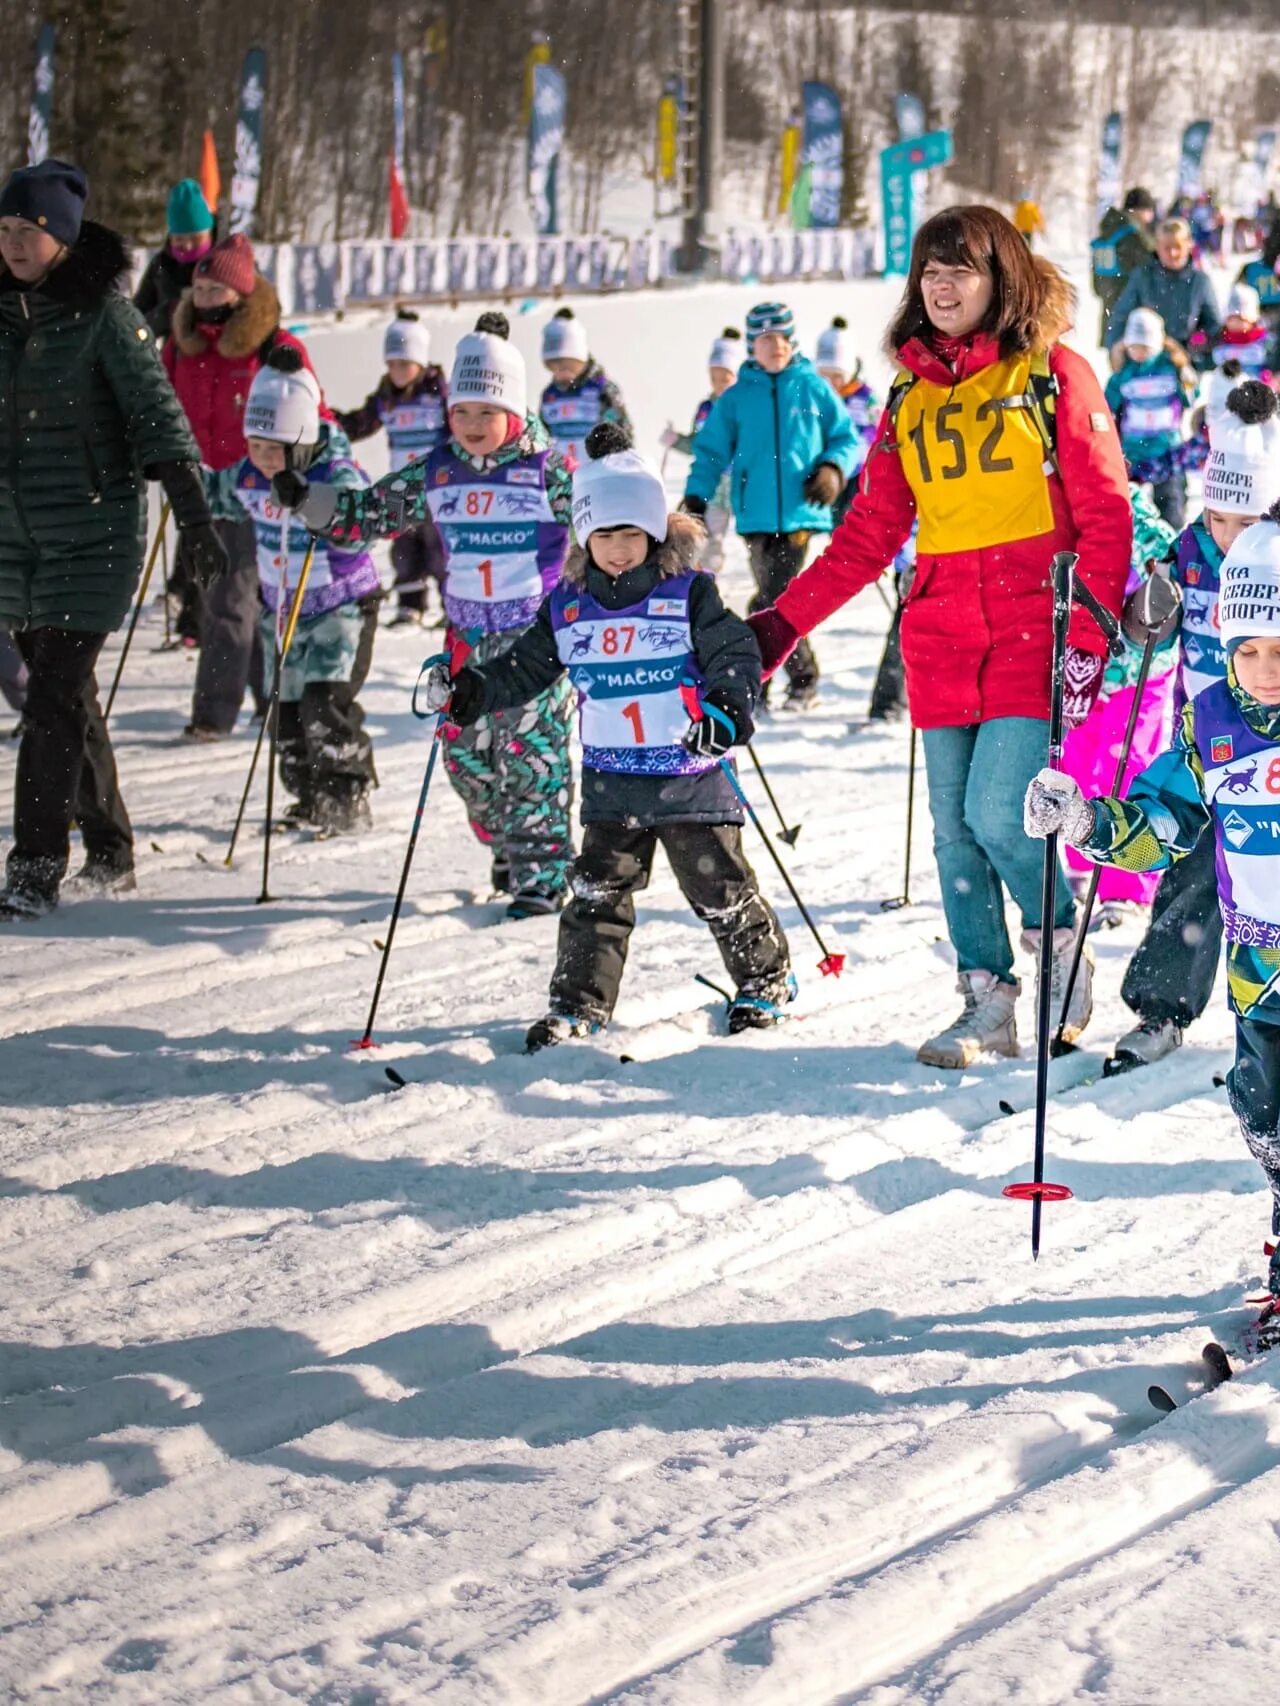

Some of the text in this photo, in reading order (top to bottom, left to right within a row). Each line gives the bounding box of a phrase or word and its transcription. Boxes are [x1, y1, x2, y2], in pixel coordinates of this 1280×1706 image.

[463, 355, 480, 366] НА
[908, 398, 1014, 483] 152
[1207, 468, 1253, 488] СЕВЕРЕ
[466, 490, 495, 517] 87
[1204, 484, 1250, 505] СПОРТ!
[476, 559, 494, 598] 1
[1226, 566, 1250, 581] НА
[602, 626, 637, 656] 87
[621, 701, 646, 745] 1
